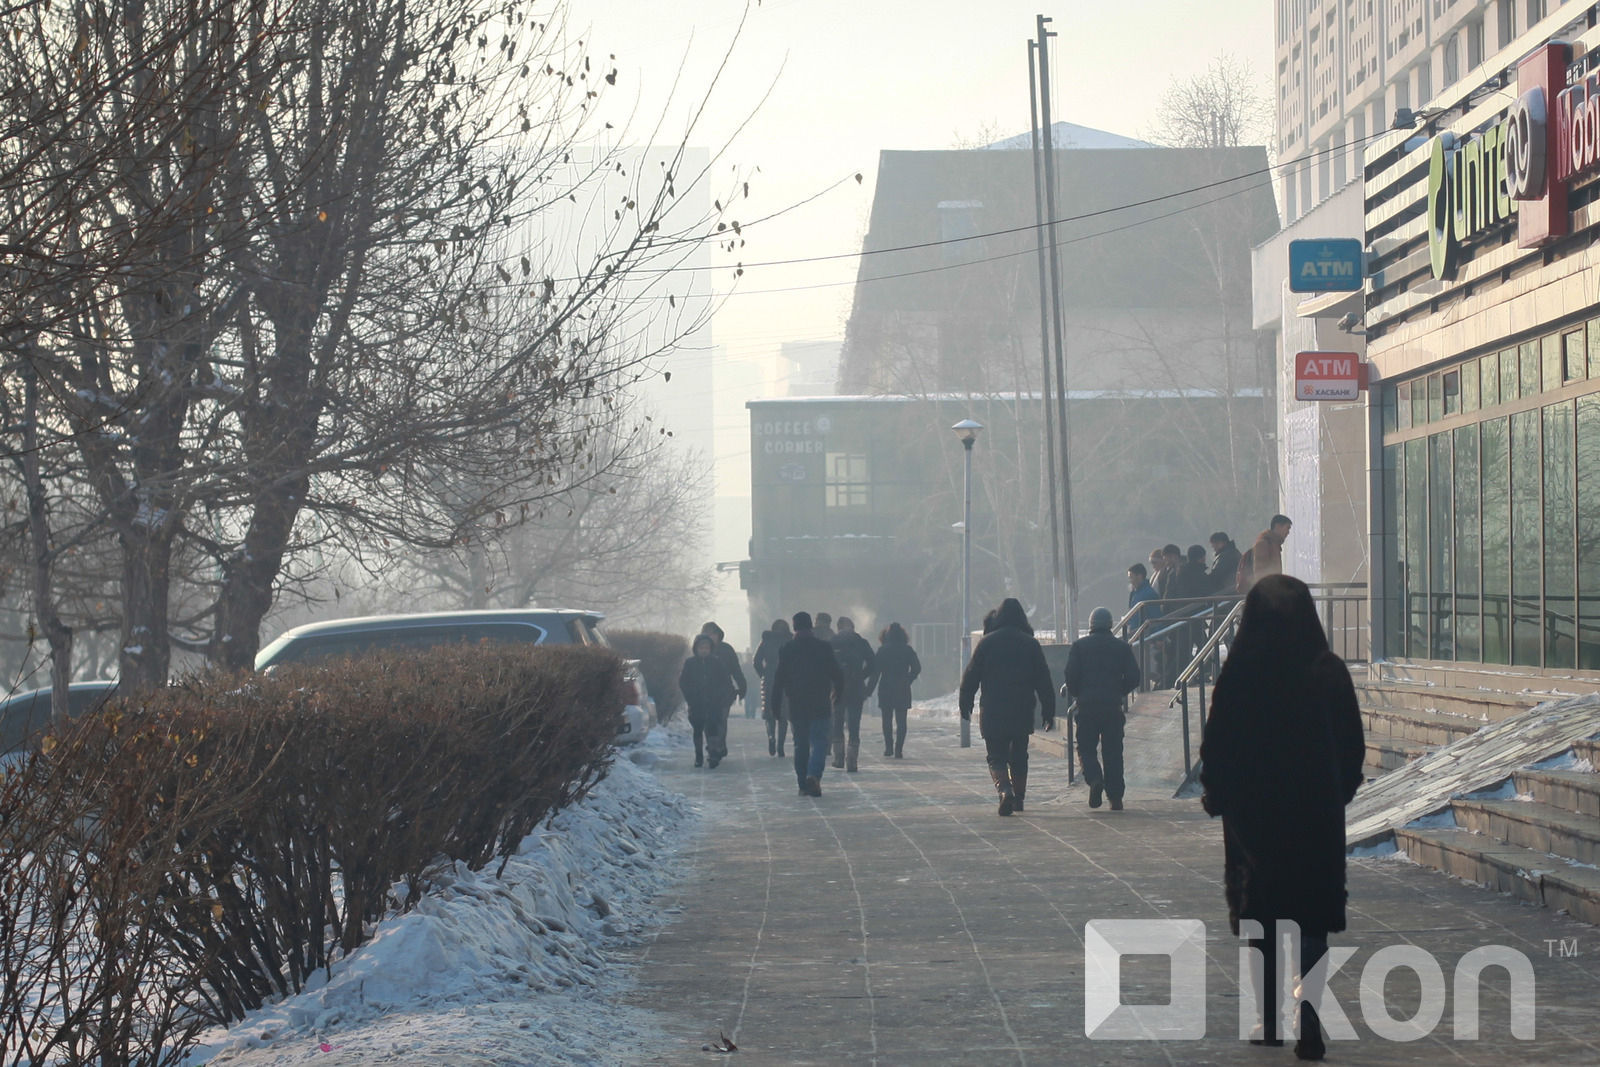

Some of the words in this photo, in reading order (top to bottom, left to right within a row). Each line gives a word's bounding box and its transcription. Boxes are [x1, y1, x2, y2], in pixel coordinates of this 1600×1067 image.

[1301, 261, 1353, 276] ATM
[1303, 359, 1351, 376] ATM
[764, 440, 824, 455] CORNER
